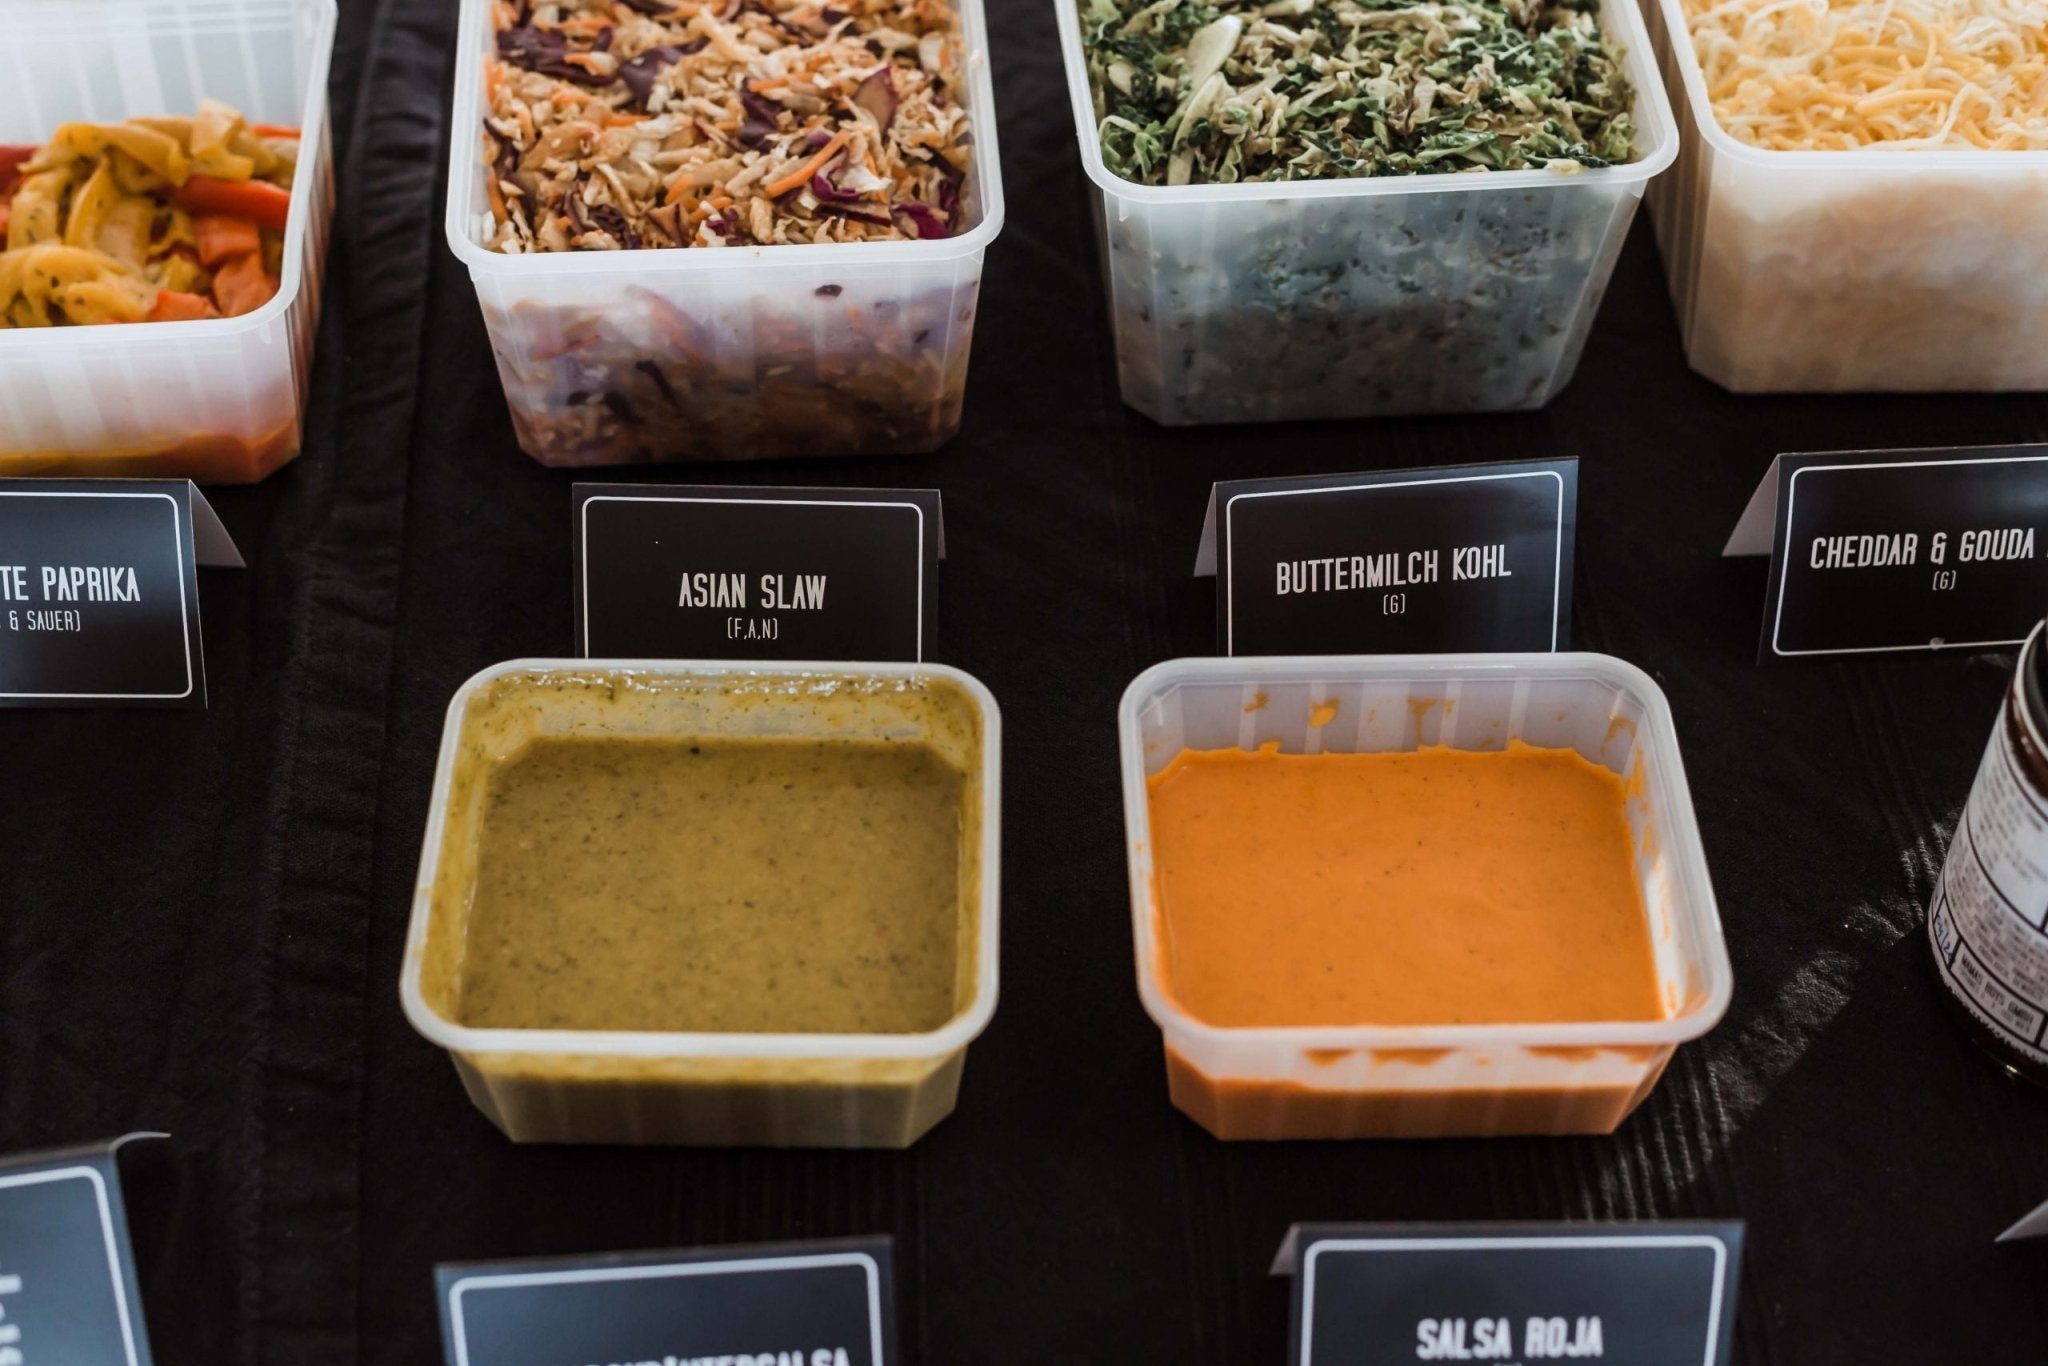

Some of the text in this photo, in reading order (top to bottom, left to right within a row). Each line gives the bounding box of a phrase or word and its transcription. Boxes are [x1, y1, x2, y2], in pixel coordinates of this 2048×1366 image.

[1810, 527, 2035, 569] CHEDDAR & GOUDA
[41, 566, 141, 602] PAPRIKA
[1276, 543, 1512, 596] BUTTERMILCH KOHL
[678, 572, 827, 610] ASIAN SLAW
[8, 609, 81, 633] & SAUER)
[1416, 1315, 1604, 1360] SALSA ROJA
